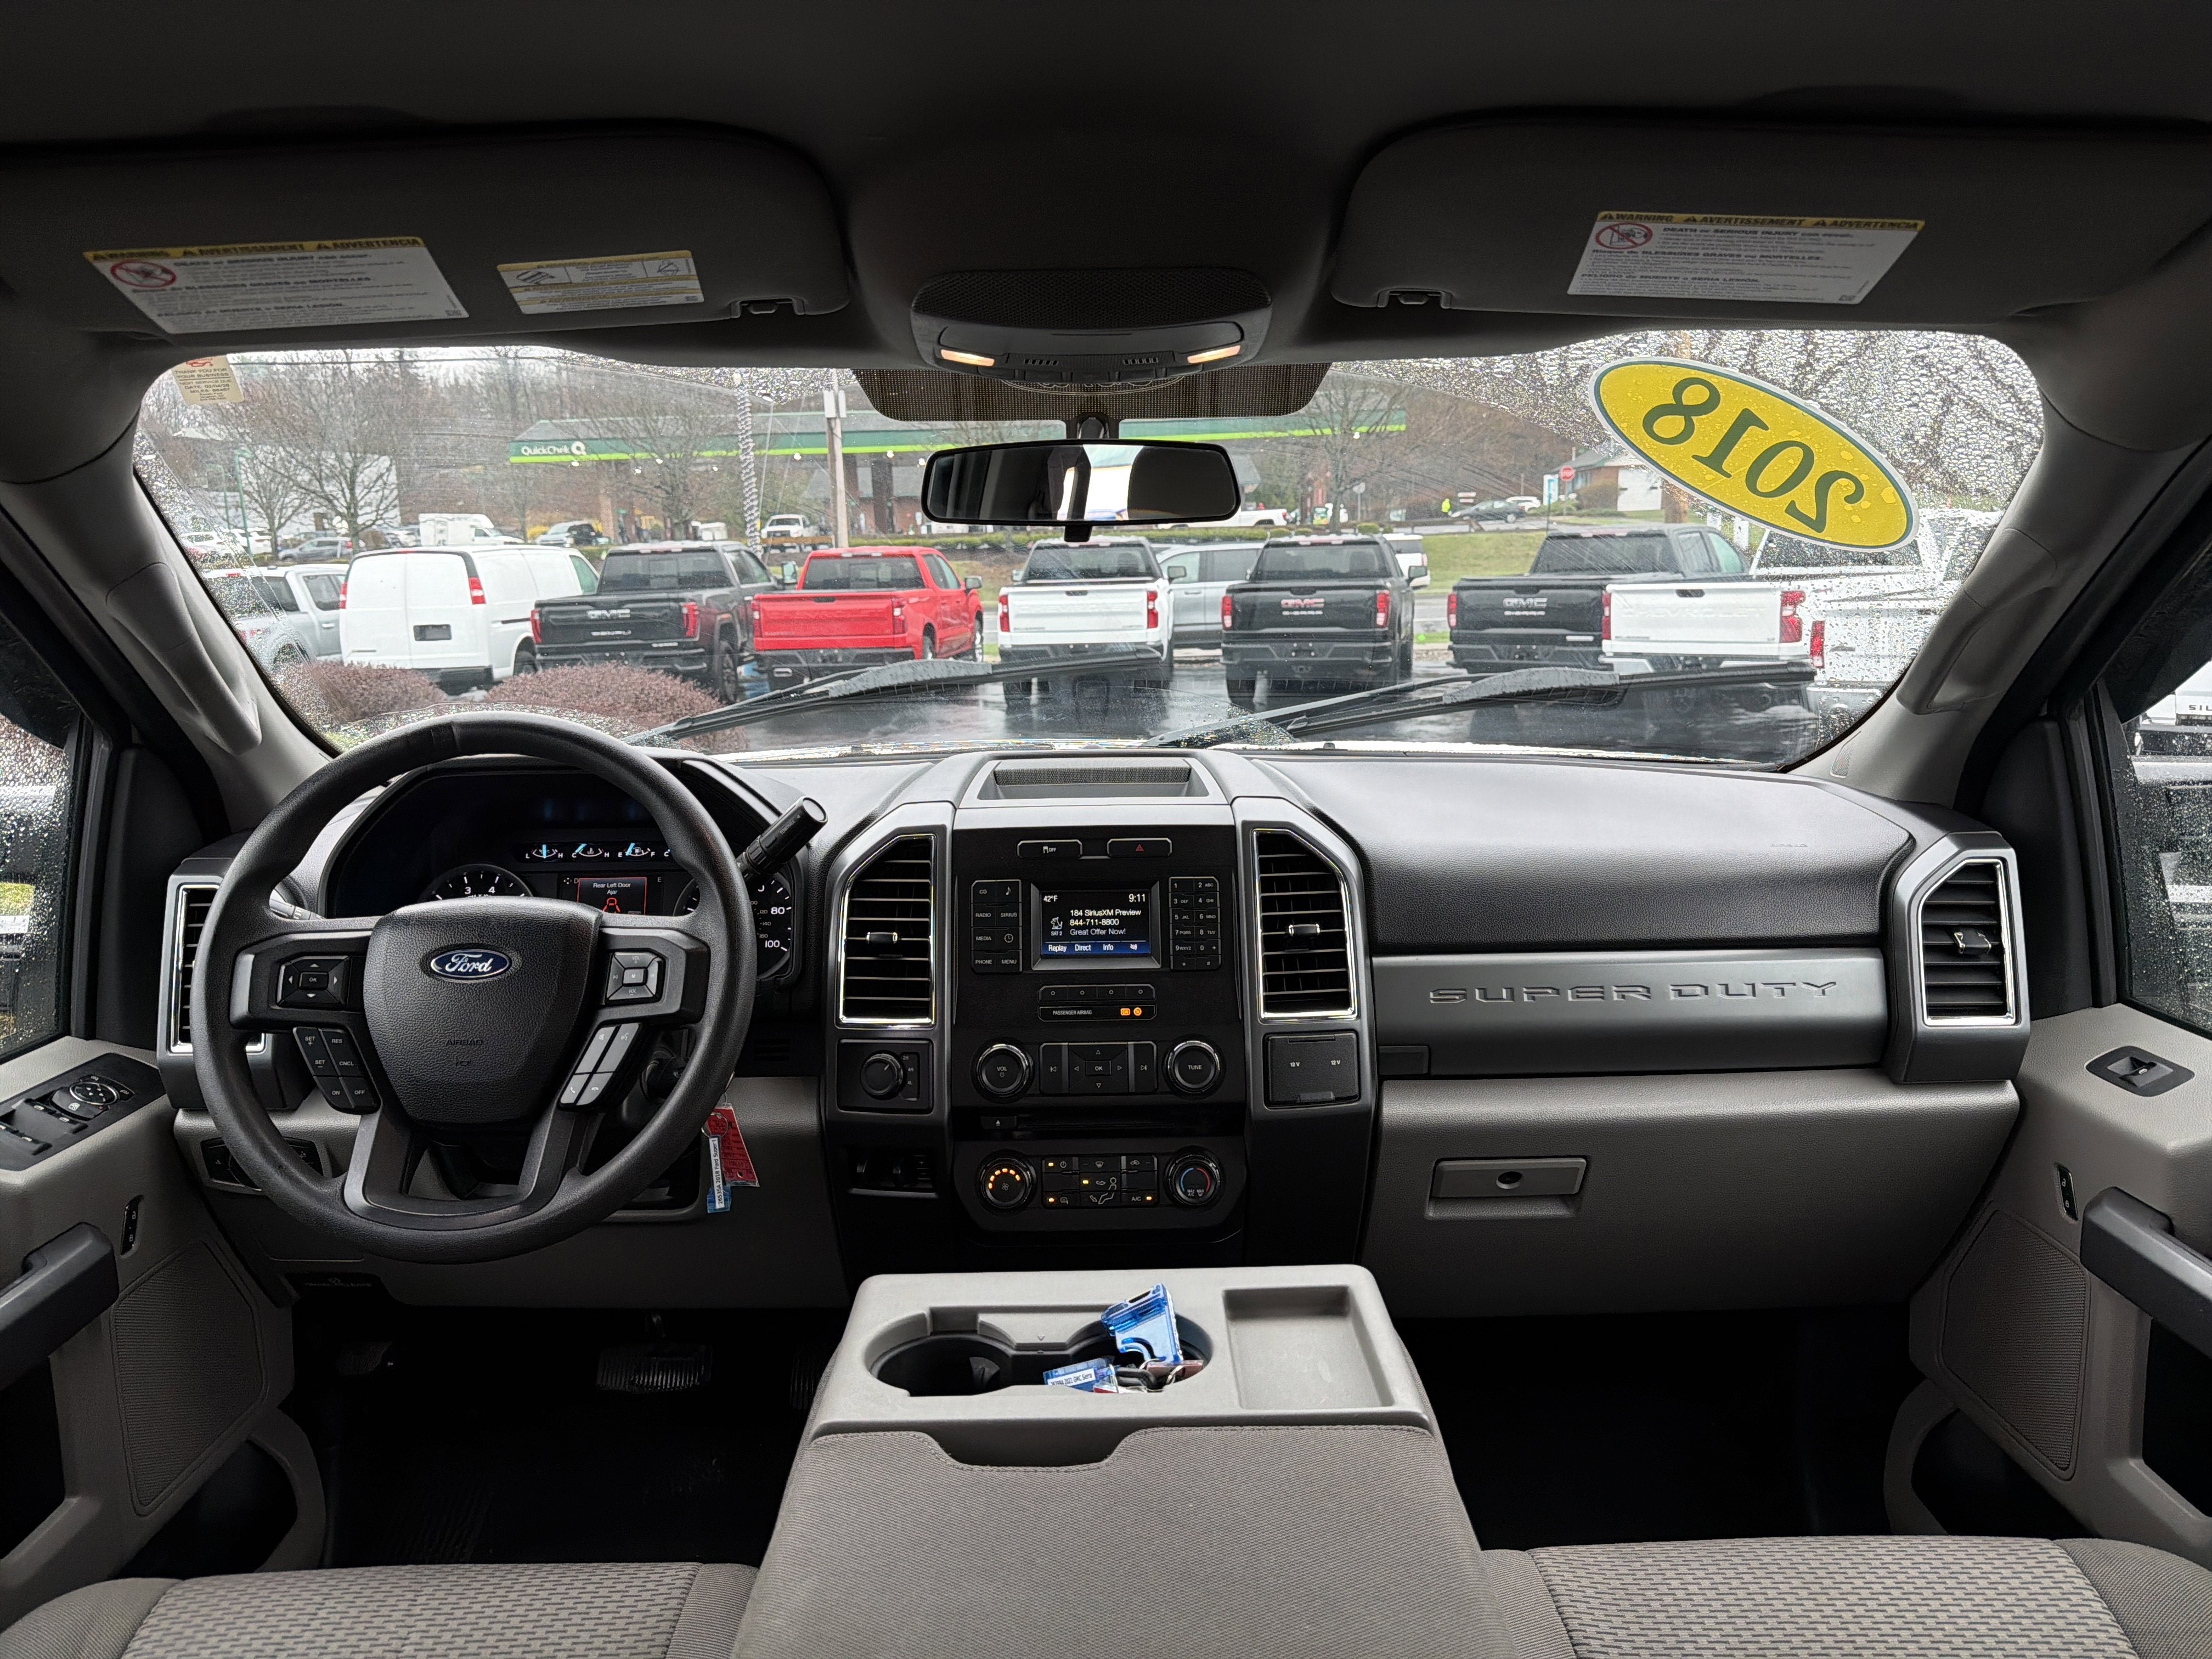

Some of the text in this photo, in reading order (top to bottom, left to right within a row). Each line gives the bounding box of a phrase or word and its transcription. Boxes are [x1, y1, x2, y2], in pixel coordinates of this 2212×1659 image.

[1700, 216, 1803, 226] AVERTISSEMENT
[1830, 220, 1918, 229] ADVERTENCIA
[521, 445, 571, 455] QuickChek
[1281, 599, 1325, 608] GMC
[1503, 598, 1548, 608] GMC
[588, 609, 630, 619] GMC
[1128, 894, 1146, 902] 9:11
[765, 940, 780, 948] 100
[1048, 944, 1066, 952] Replay
[445, 953, 494, 972] Ford
[1429, 981, 1837, 1005] SUPER DUTY
